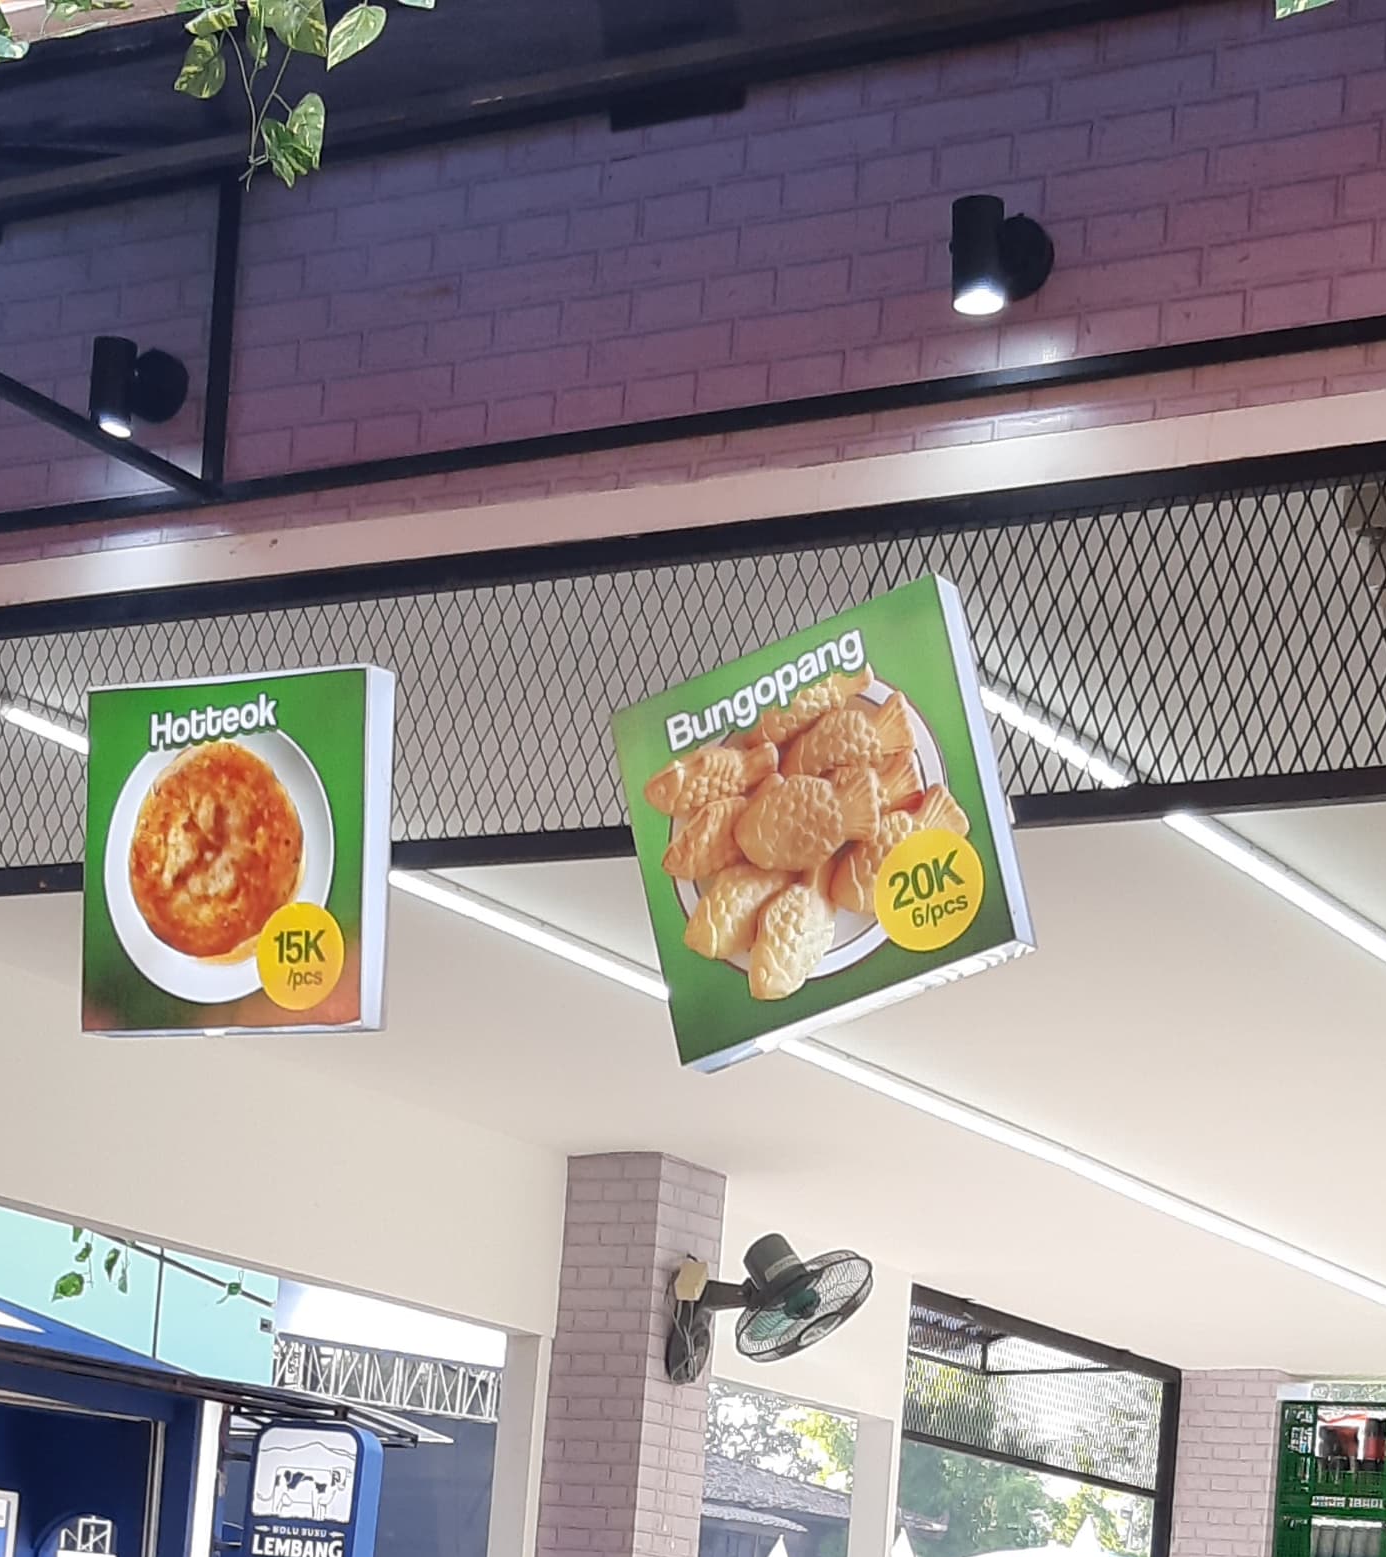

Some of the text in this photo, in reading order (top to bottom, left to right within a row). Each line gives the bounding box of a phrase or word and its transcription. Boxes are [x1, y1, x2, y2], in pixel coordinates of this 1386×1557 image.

[666, 629, 867, 754] Bungopang
[148, 693, 278, 747] Hotteok
[887, 850, 965, 911] 20K
[910, 891, 969, 931] 6/pcs
[273, 929, 327, 967] 15K
[286, 966, 324, 990] /pcs
[272, 1525, 299, 1535] BOLU
